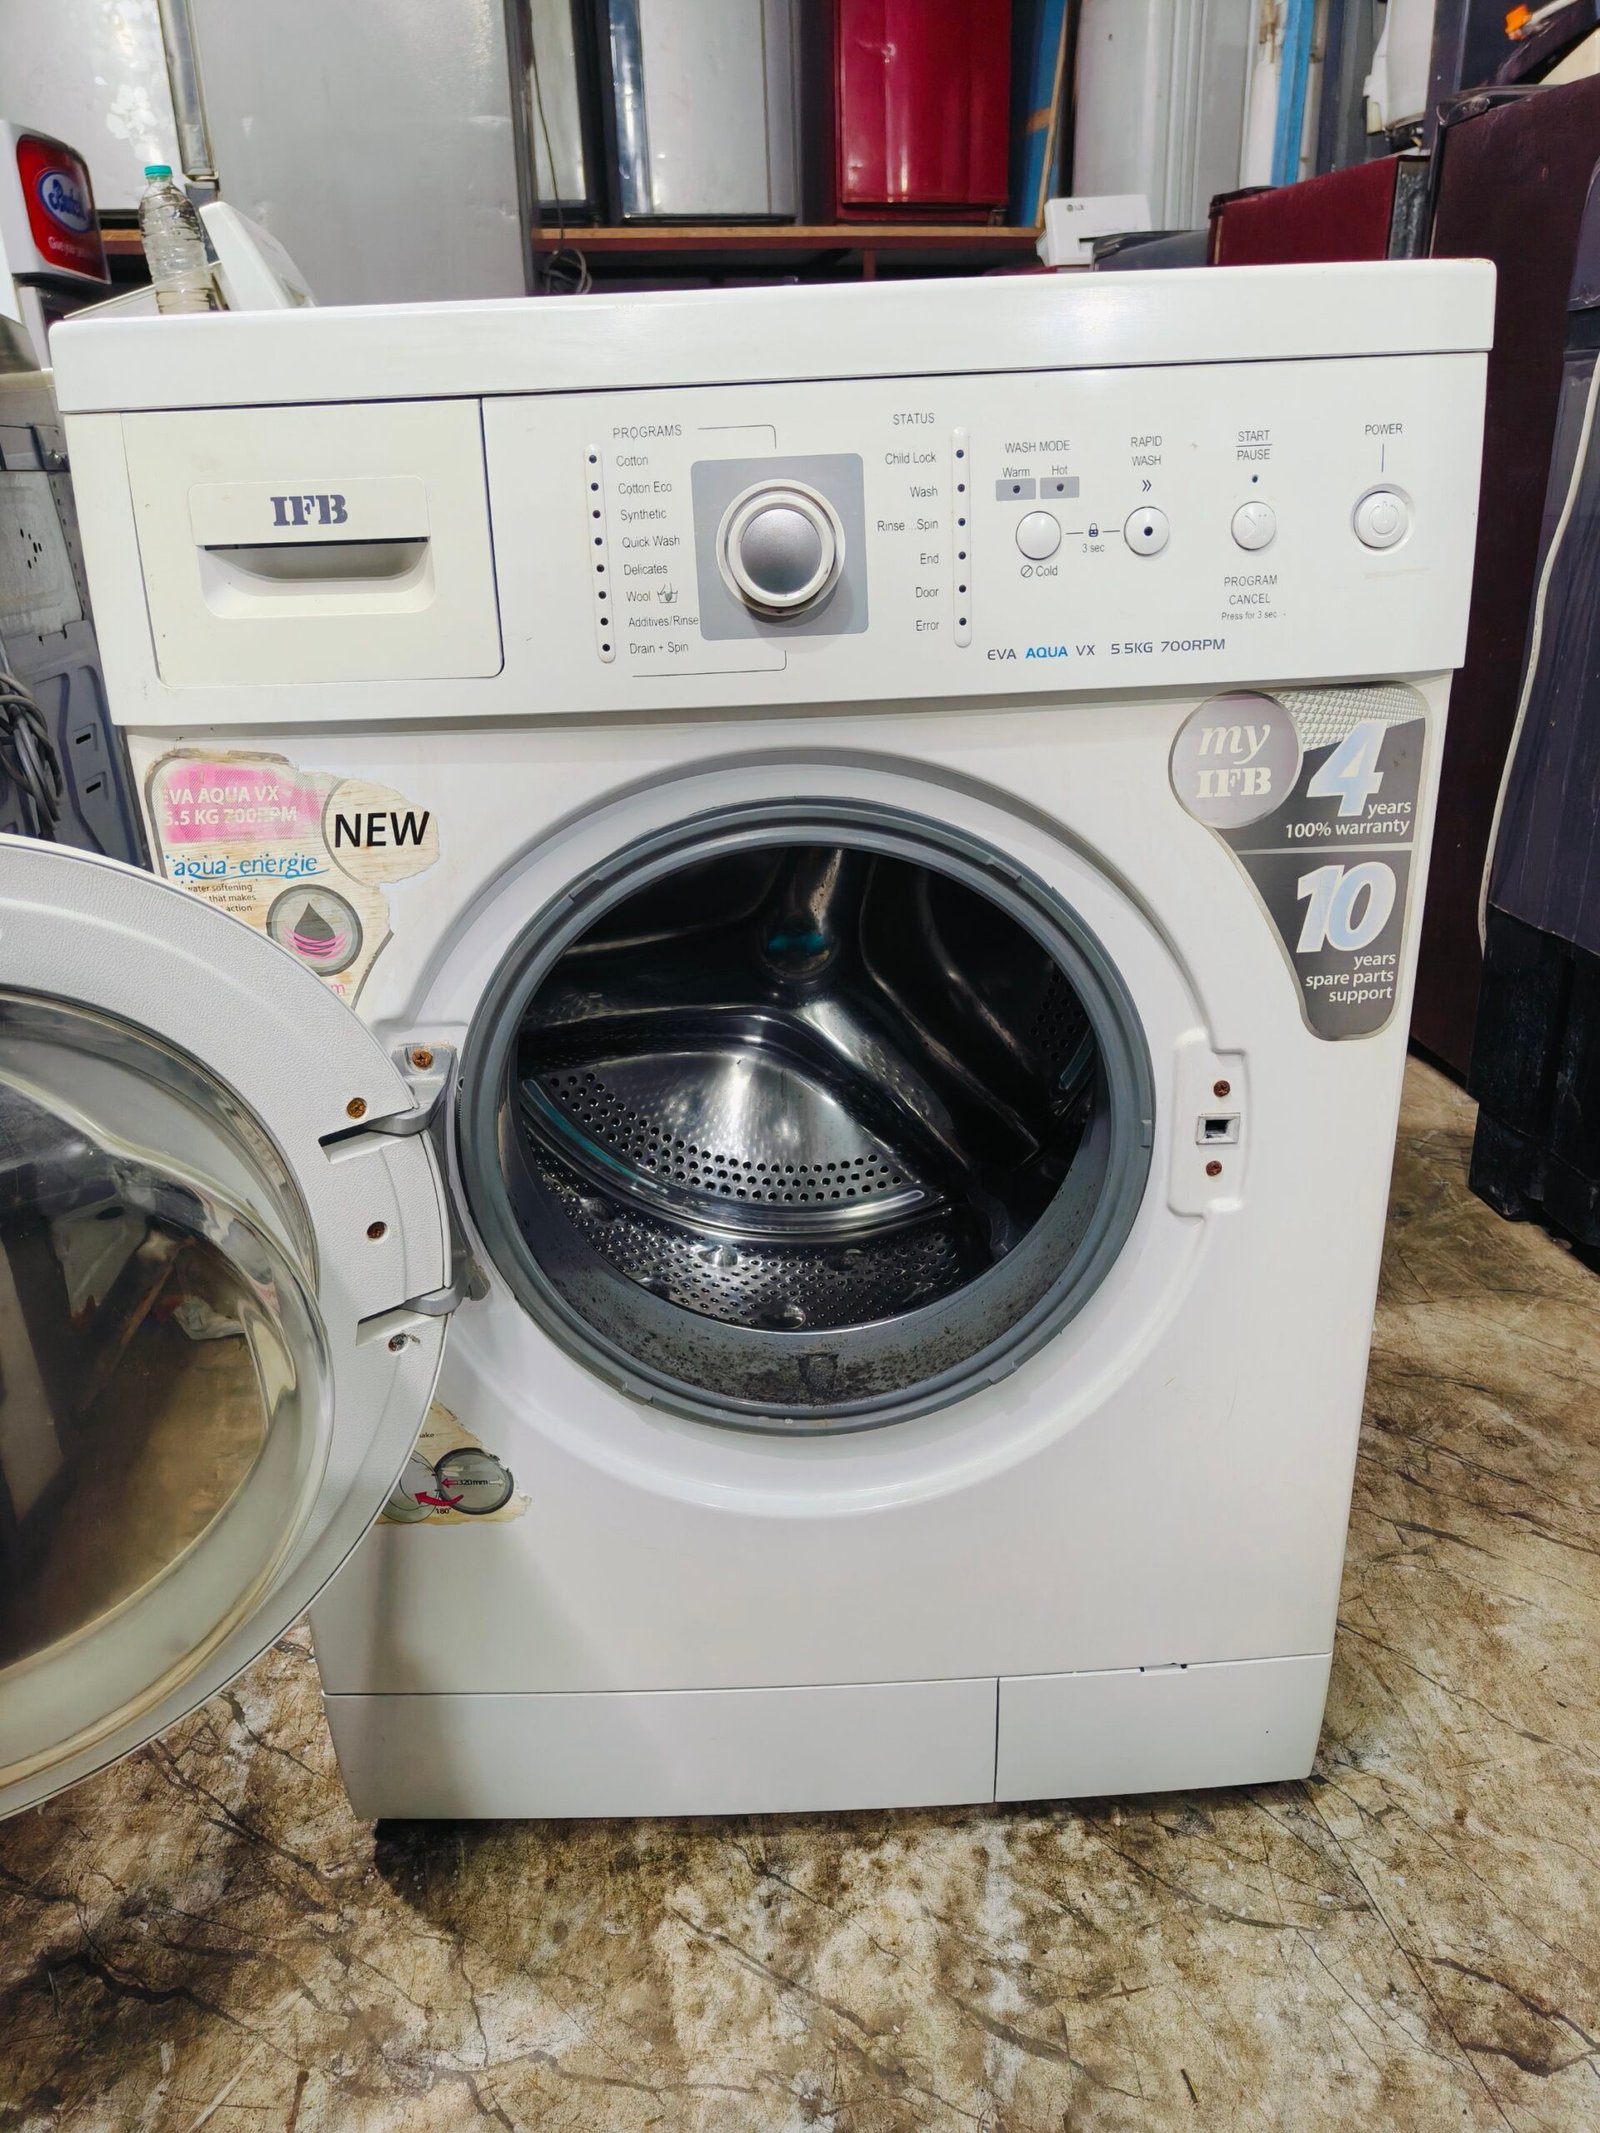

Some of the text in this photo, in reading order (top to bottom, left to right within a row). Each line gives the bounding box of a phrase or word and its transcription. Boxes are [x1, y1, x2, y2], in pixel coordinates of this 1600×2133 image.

[893, 412, 935, 425] STATUS
[612, 424, 682, 440] PROGRAMS
[1237, 430, 1270, 442] START
[1364, 423, 1403, 436] POWER
[1004, 440, 1071, 453] WASH MODE
[1130, 435, 1163, 447] RAPID
[616, 455, 649, 468] Cotton
[885, 452, 937, 465] Child Lock
[1131, 454, 1162, 467] WASH
[1236, 449, 1271, 461] PAUSE
[1002, 466, 1031, 478] Warm
[1051, 465, 1068, 476] Hot
[618, 480, 673, 496] Cotton Eco
[909, 486, 939, 498] Wash
[270, 494, 348, 526] IFB
[620, 509, 668, 524] Synthetic
[877, 520, 906, 532] Rinse
[622, 535, 681, 549] Quick Wash
[1082, 543, 1105, 553] 3 sec
[919, 553, 940, 565] End
[623, 564, 669, 576] Delicates
[1035, 565, 1059, 578] Cold
[1224, 574, 1278, 588] PROGRAM
[626, 590, 651, 603] Wool
[915, 586, 939, 599] Door
[1229, 593, 1271, 606] CANCEL
[628, 615, 699, 628] Additives/Rinse
[1221, 610, 1278, 622] Press for 3 sec
[915, 620, 940, 632] Error
[629, 642, 656, 655] Drain
[667, 641, 689, 655] Spin
[987, 649, 1017, 662] EVA
[1025, 645, 1068, 659] AQUA
[1076, 644, 1096, 657] VX
[1160, 638, 1226, 652] 700RPM
[1200, 723, 1271, 765] my
[1306, 719, 1412, 819] 4 years
[1195, 767, 1272, 799] IFB
[198, 786, 251, 806] AQUA
[254, 785, 280, 802] VX
[194, 809, 219, 826] KG
[335, 811, 430, 848] NEW
[1285, 819, 1410, 839] 100% warranty
[211, 883, 253, 893] softening
[228, 893, 257, 902] makes
[225, 904, 253, 912] action
[1296, 861, 1397, 953] 10
[1353, 953, 1397, 970] years
[1305, 969, 1394, 989] spare parts
[1329, 987, 1393, 1005] support
